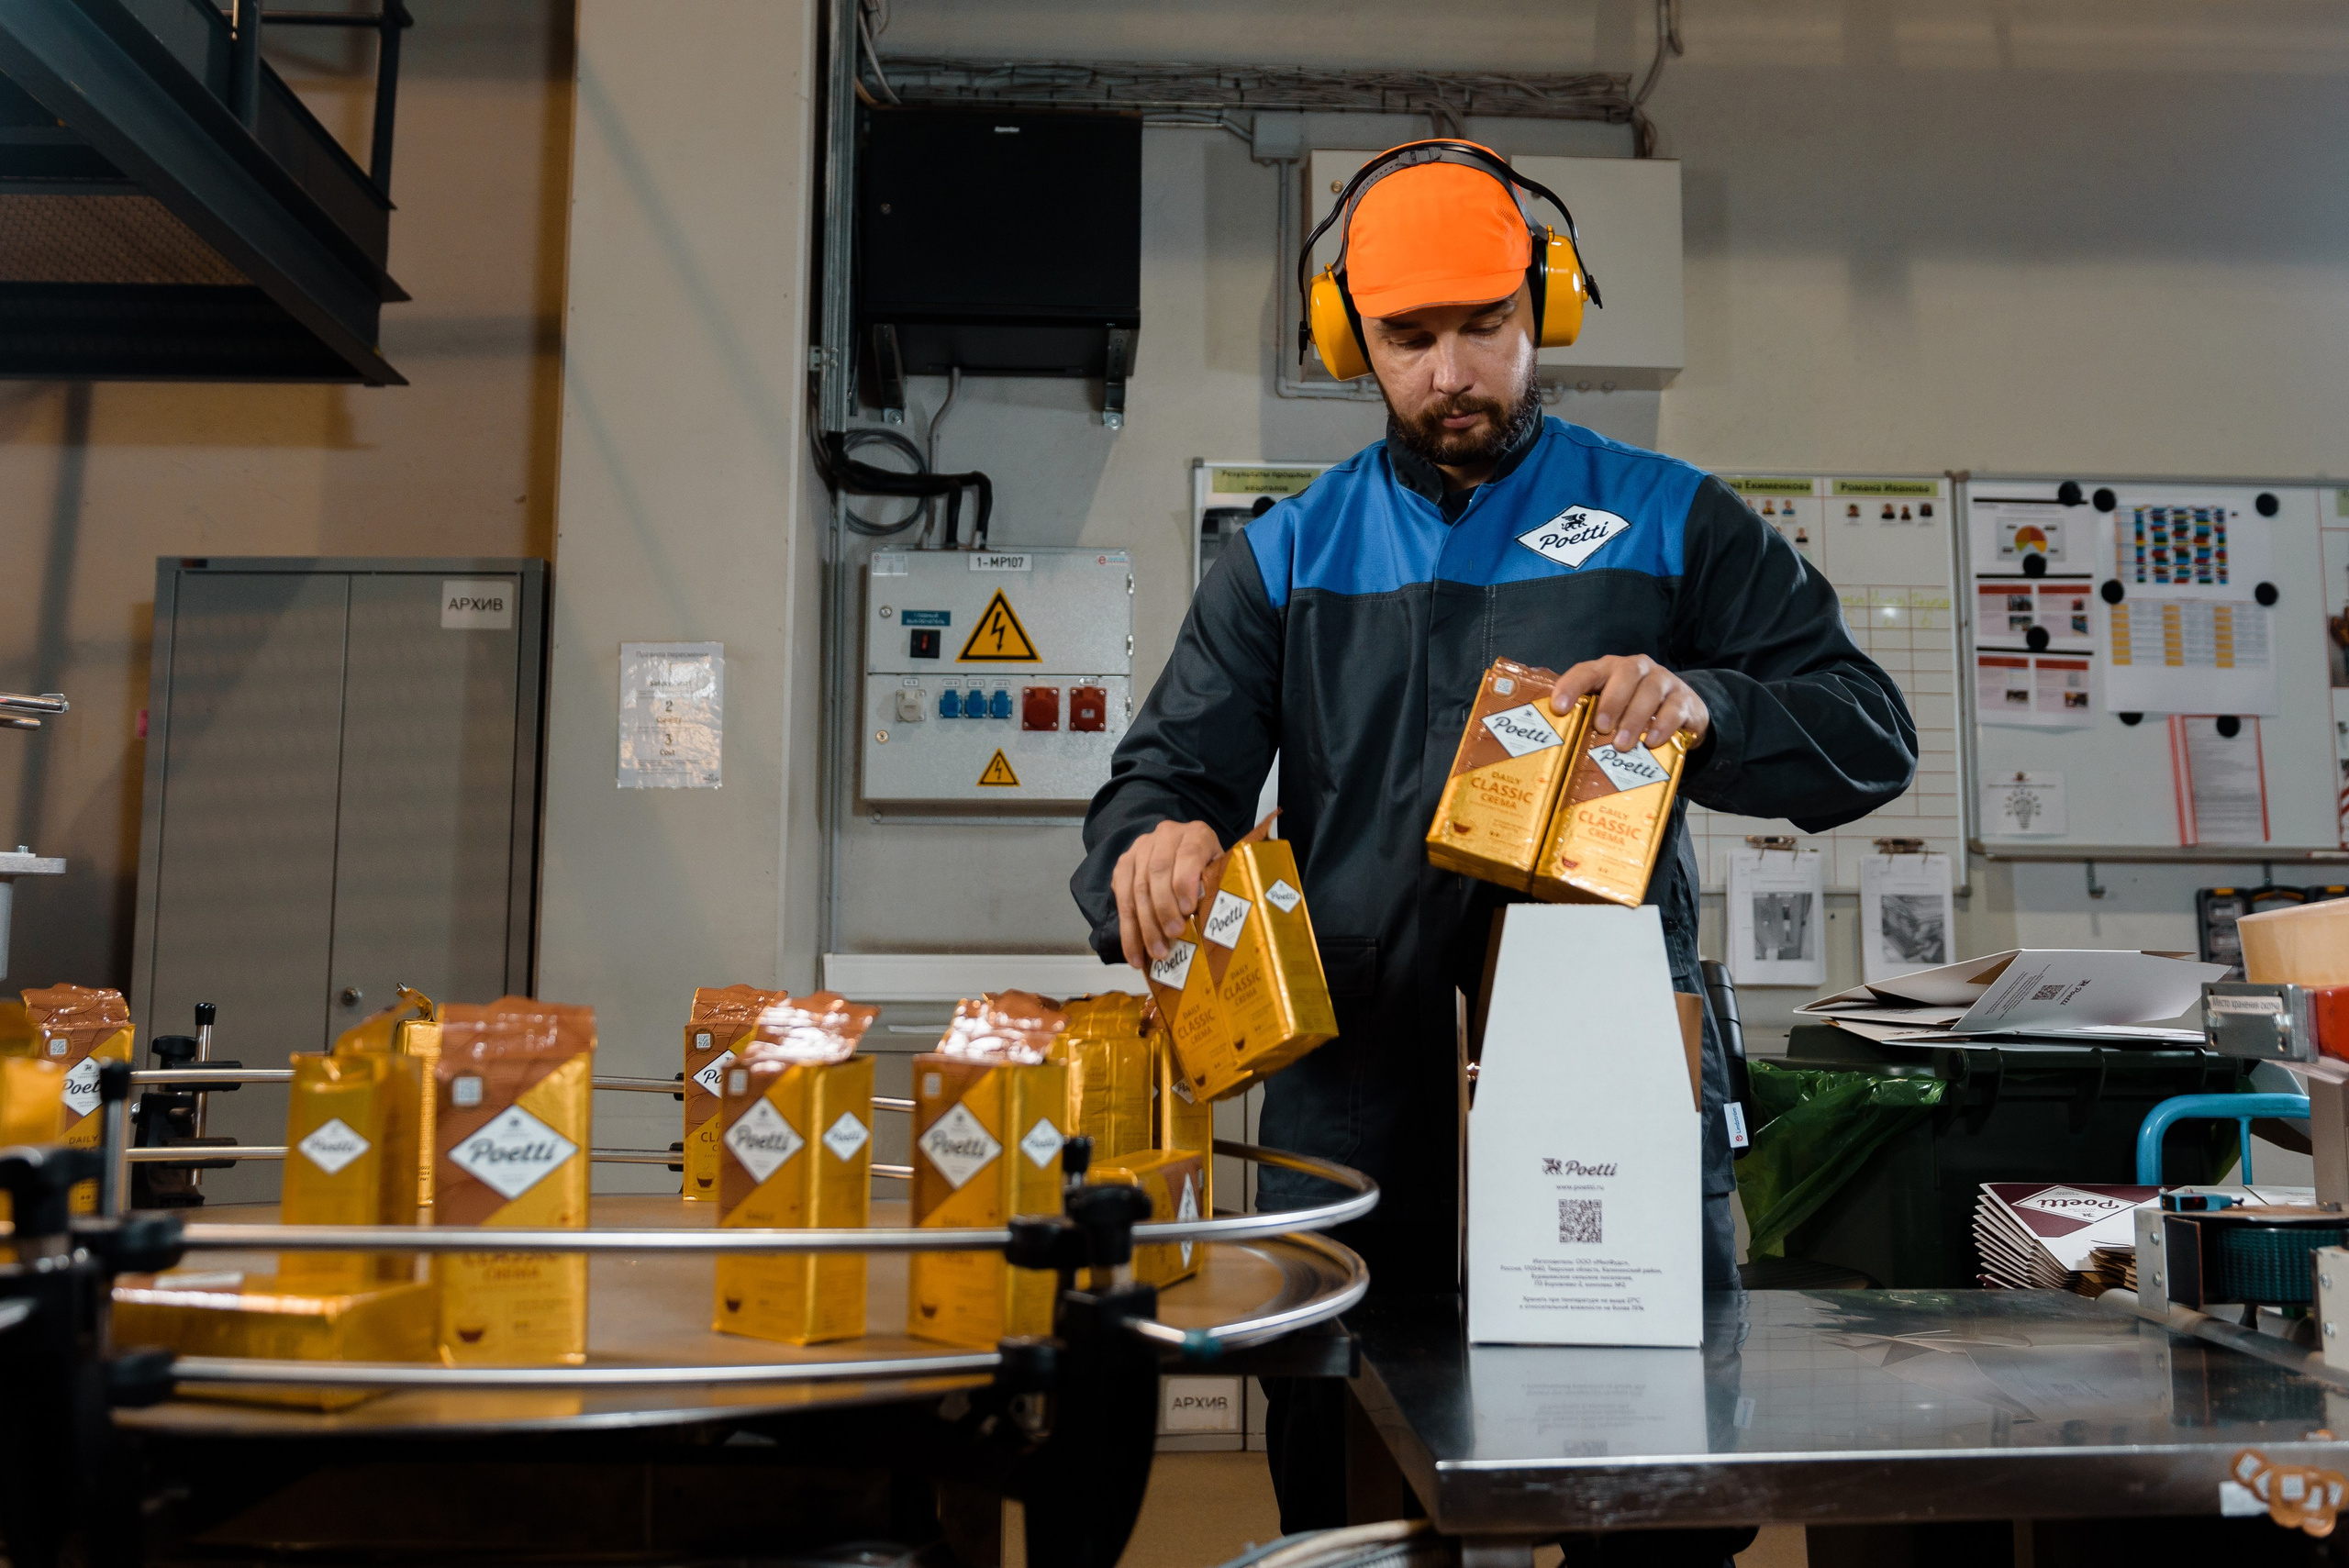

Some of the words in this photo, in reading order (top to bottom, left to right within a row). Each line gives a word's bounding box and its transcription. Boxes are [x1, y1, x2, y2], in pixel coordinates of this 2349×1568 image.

[1539, 520, 1609, 550] Poetti
[448, 596, 504, 611] АРХИВ
[665, 699, 674, 713] 2
[1493, 715, 1553, 745] Poetti
[665, 733, 673, 747] 3
[1598, 749, 1660, 779] Poetti
[1490, 771, 1522, 784] DAILY
[1470, 776, 1535, 805] CLASSIC
[1480, 793, 1519, 810] CREMA
[1598, 805, 1631, 821] DAILY
[1577, 810, 1643, 841] CLASSIC
[1587, 826, 1627, 847] CREMA
[1208, 902, 1244, 938] Poetti
[1153, 944, 1189, 979] Poetti
[1222, 968, 1263, 1002] CLASSIC
[1176, 1011, 1217, 1040] CLASSIC
[62, 1077, 102, 1095] Poet
[69, 1134, 99, 1145] DAILY
[468, 1138, 559, 1164] Poetti
[1564, 1160, 1619, 1176] Poetti
[2036, 1198, 2121, 1210] Poetti
[1172, 1396, 1229, 1410] АРХИВ
